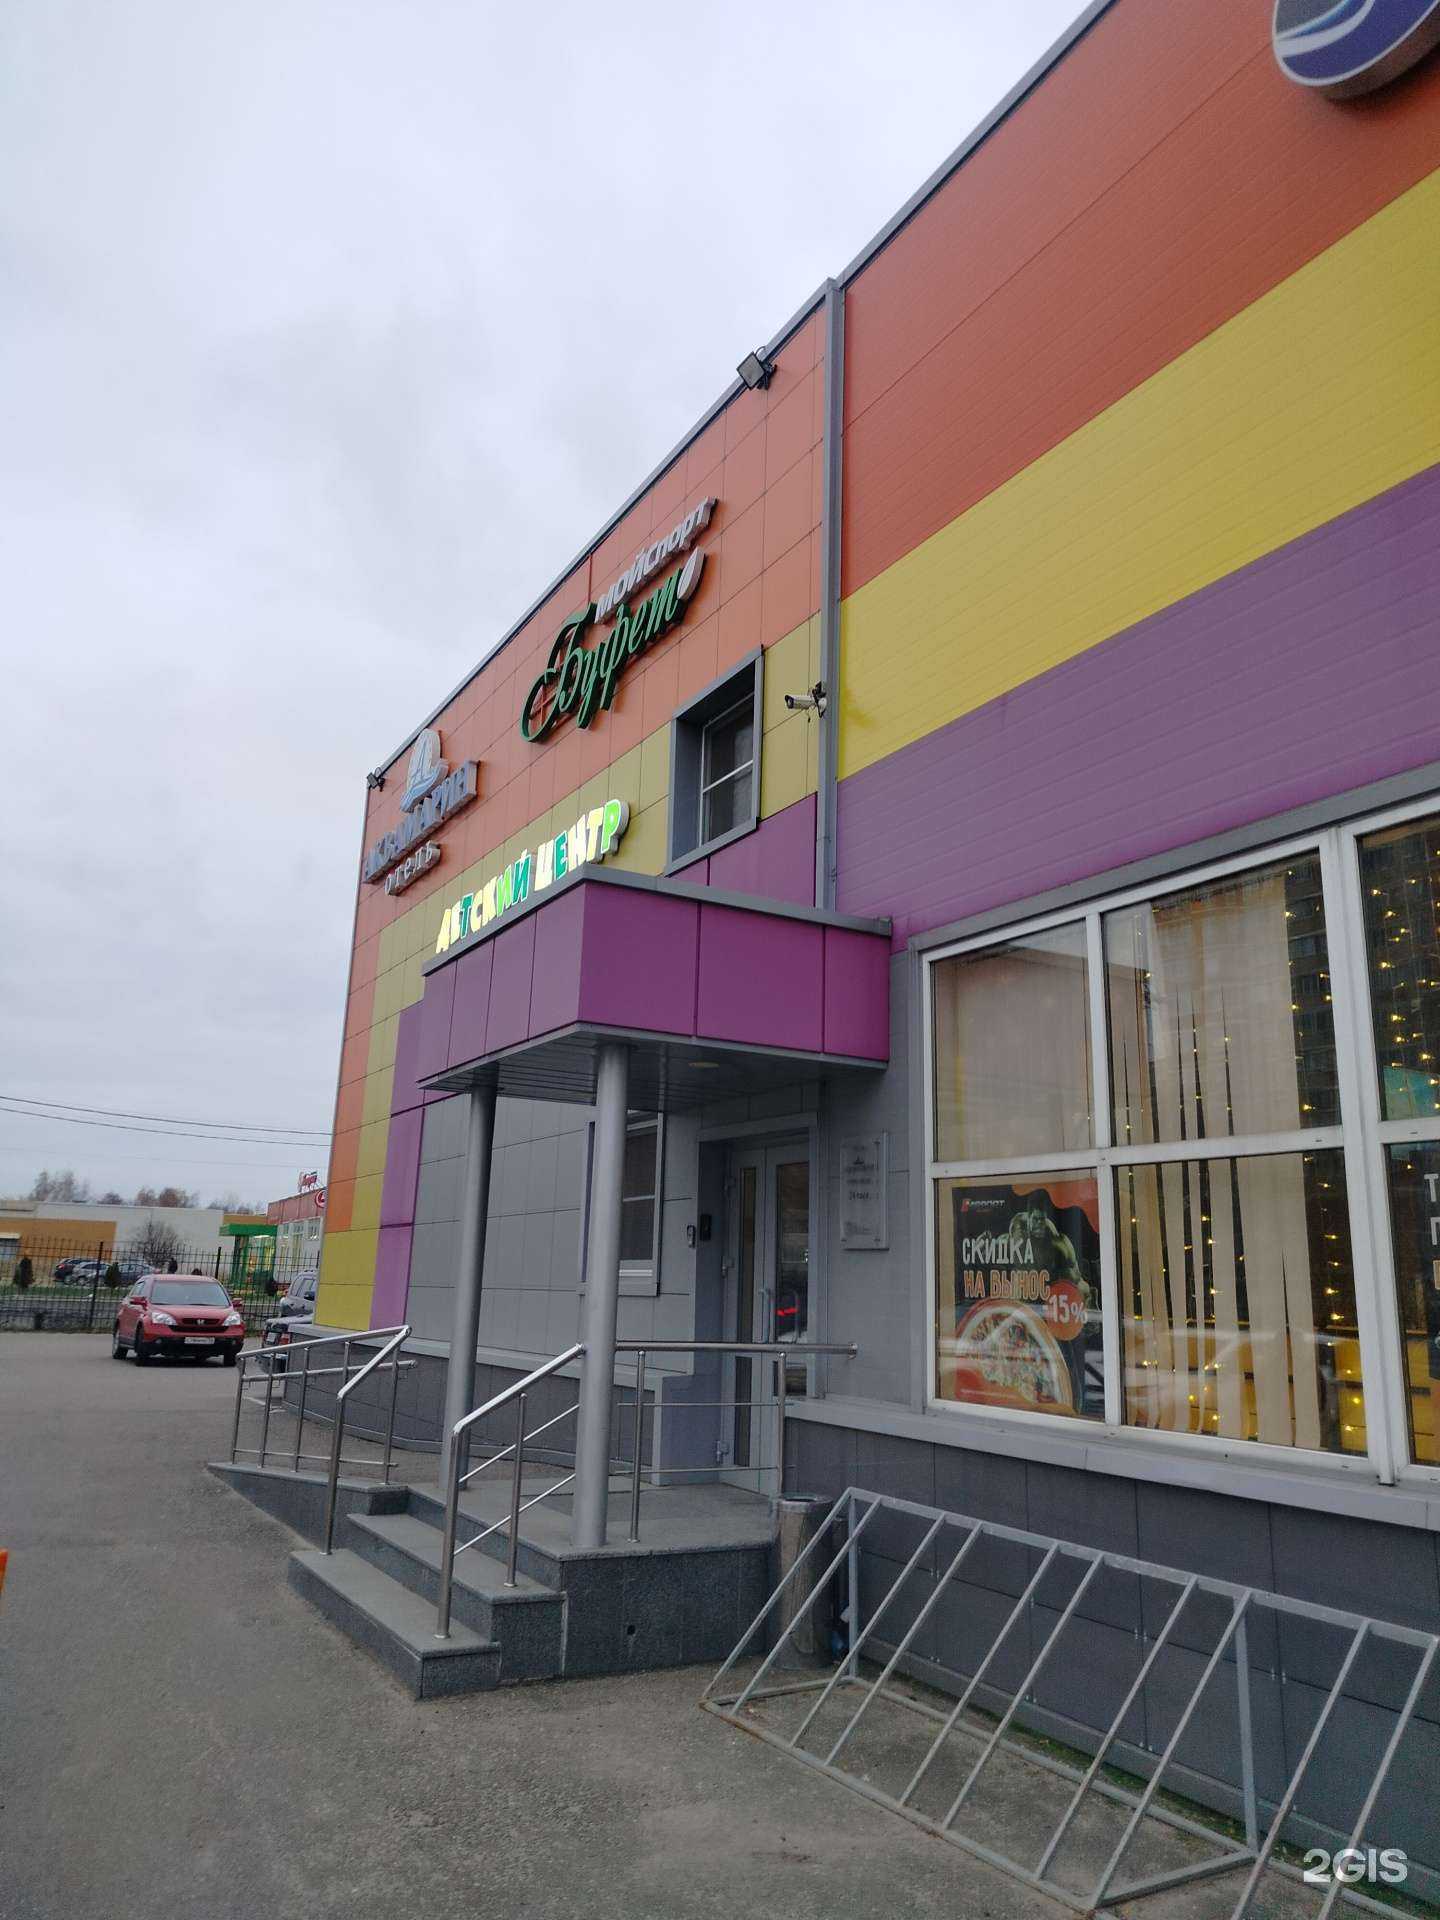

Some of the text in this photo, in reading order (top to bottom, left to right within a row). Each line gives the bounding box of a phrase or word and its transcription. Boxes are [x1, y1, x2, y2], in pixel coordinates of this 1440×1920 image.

[534, 799, 622, 891] ЦЕНТР
[962, 1237, 1034, 1264] СКИДКА
[963, 1269, 1050, 1300] НА ВЫНОС
